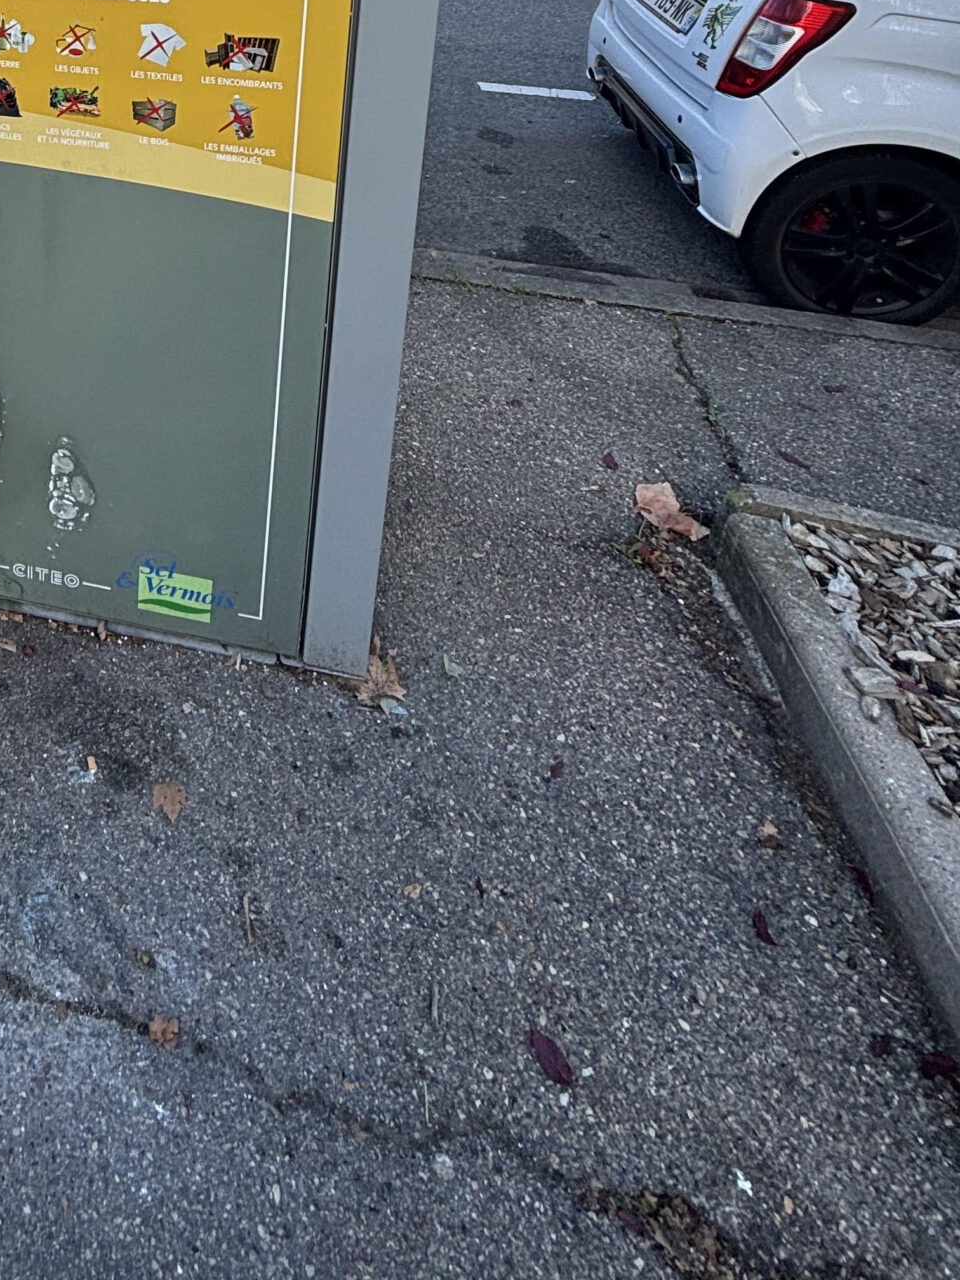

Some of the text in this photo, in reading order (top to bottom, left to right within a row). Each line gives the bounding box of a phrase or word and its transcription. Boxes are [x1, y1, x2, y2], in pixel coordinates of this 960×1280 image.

[54, 64, 99, 75] LES OBJETS
[130, 70, 183, 81] LES TEXTILES
[201, 76, 283, 90] LES ENCOMBRANTS
[46, 127, 102, 139] LES VÉGÉTAUX
[60, 138, 110, 150] NOURRITURE
[150, 137, 169, 146] BOIS
[204, 142, 276, 157] LES EMBALLAGES
[216, 153, 262, 165] IMBRIQUÉS
[140, 558, 176, 579] Sel
[13, 563, 80, 588] CITEO
[146, 575, 235, 609] Vermois
